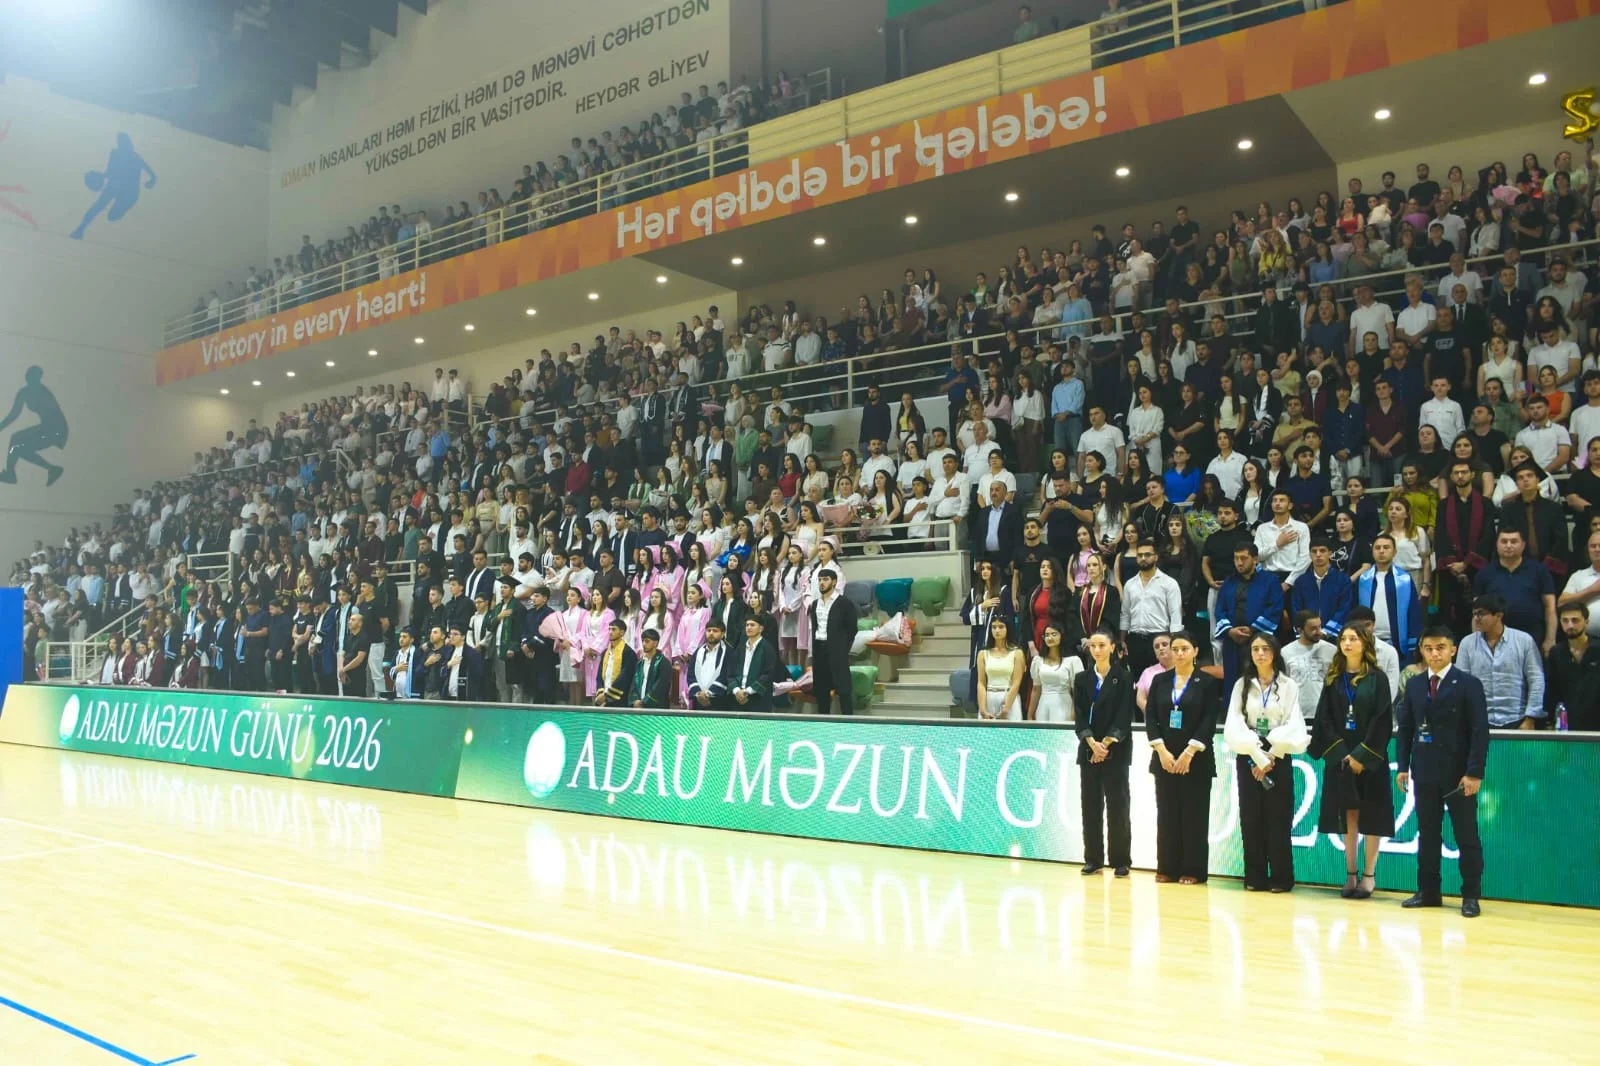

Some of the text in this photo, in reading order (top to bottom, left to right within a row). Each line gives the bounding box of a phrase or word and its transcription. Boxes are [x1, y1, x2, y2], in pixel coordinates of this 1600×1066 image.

[319, 131, 382, 172] İNSANLARI
[386, 116, 415, 143] HƏM
[464, 80, 497, 109] HƏM
[503, 70, 526, 94] DƏ
[531, 35, 596, 82] MƏNƏVİ
[602, 0, 710, 51] CƏHƏTDƏN
[365, 81, 567, 175] YÜKSƏLDƏN BİR VASİTƏDİR.
[575, 50, 710, 115] HEYDƏR ƏLİYEV
[617, 76, 1107, 248] Hər qəlbdə bir qələbə!
[201, 272, 427, 365] Victory in every heart!
[76, 699, 384, 771] ADAU MƏZUN GÜNÜ 2026
[566, 730, 711, 800] ADAU
[722, 738, 971, 822] MƏZUN
